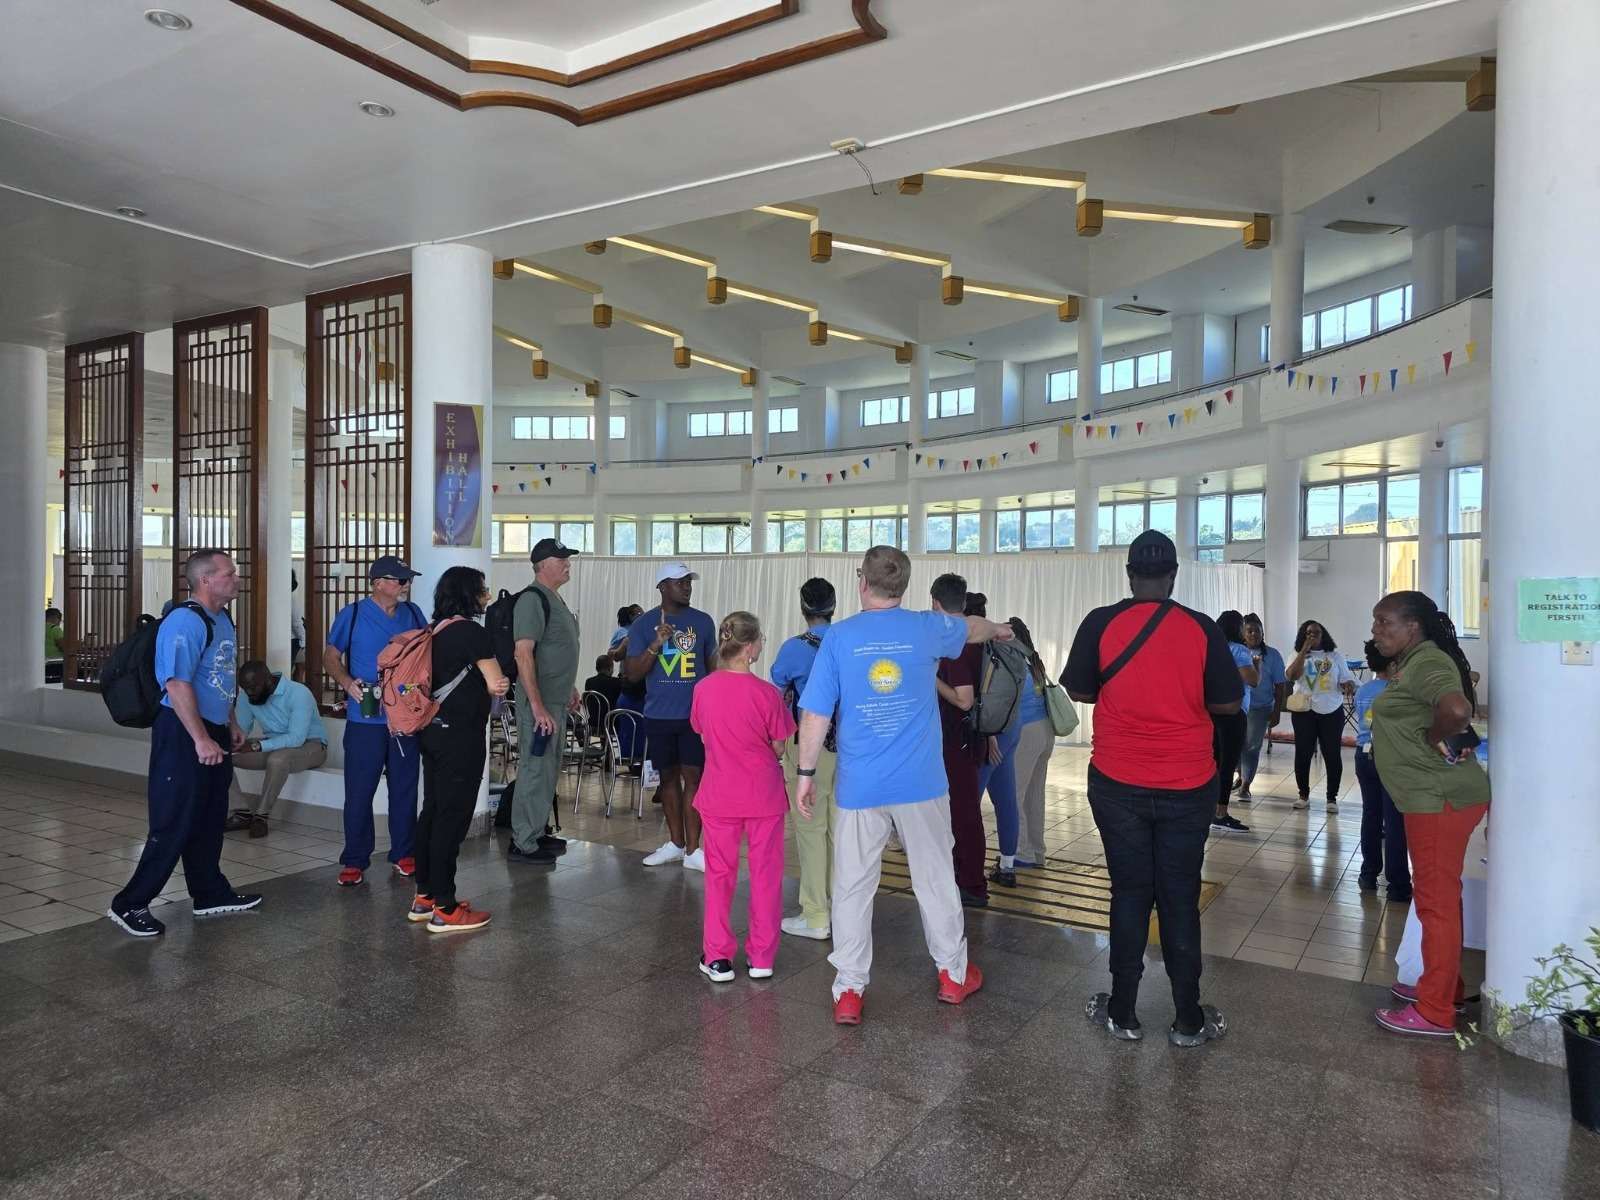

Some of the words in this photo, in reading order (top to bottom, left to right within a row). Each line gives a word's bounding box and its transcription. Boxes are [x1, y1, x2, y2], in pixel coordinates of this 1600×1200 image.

[445, 412, 456, 544] EXHIBITION
[458, 452, 468, 502] HALL
[1573, 593, 1587, 601] TO
